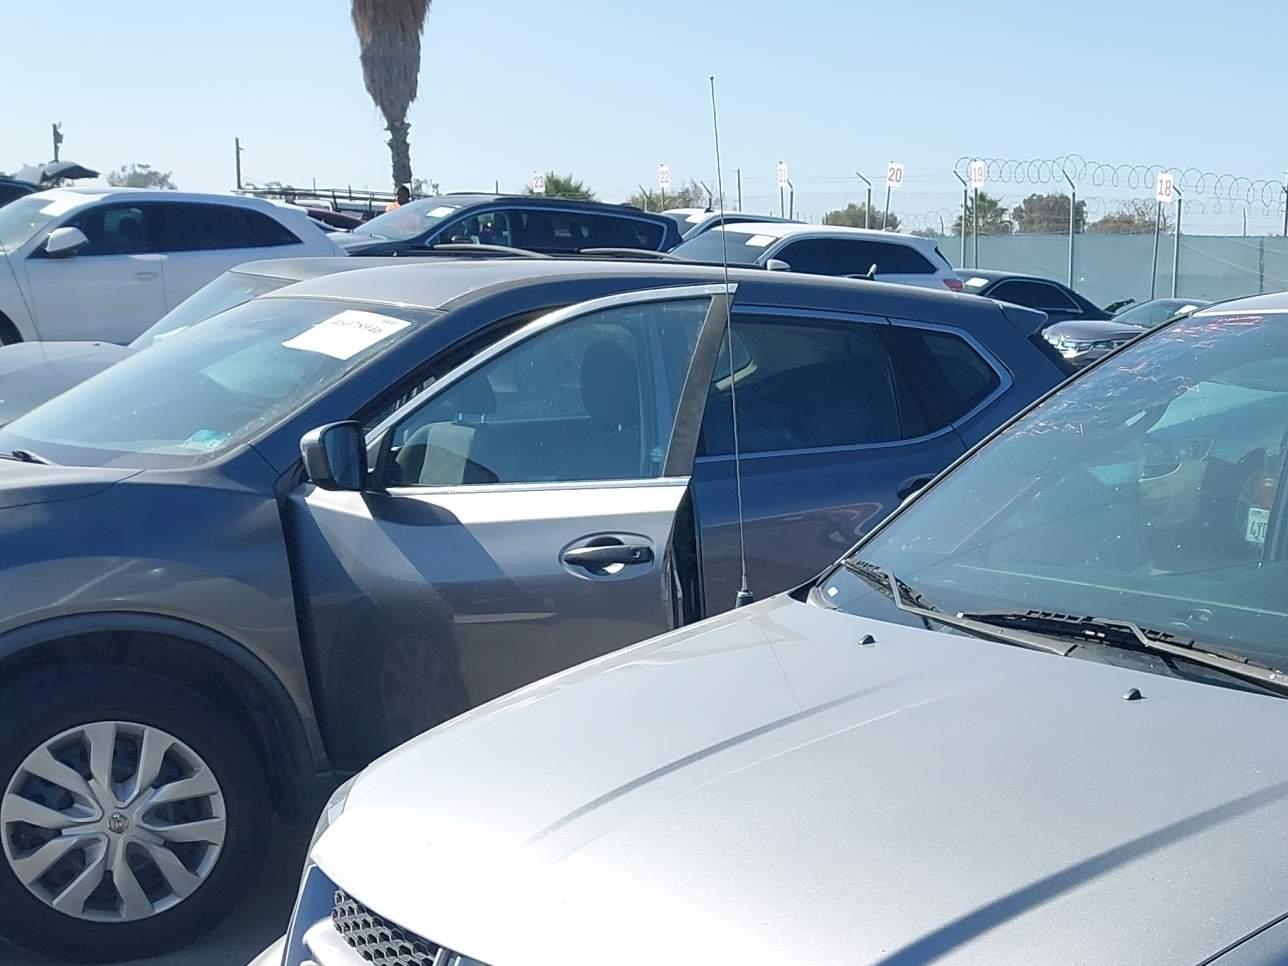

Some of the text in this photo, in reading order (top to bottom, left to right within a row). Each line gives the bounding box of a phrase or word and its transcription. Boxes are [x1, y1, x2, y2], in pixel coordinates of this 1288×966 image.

[660, 170, 669, 184] 22
[888, 167, 902, 183] 20
[972, 166, 983, 183] 19
[1158, 179, 1172, 197] 18
